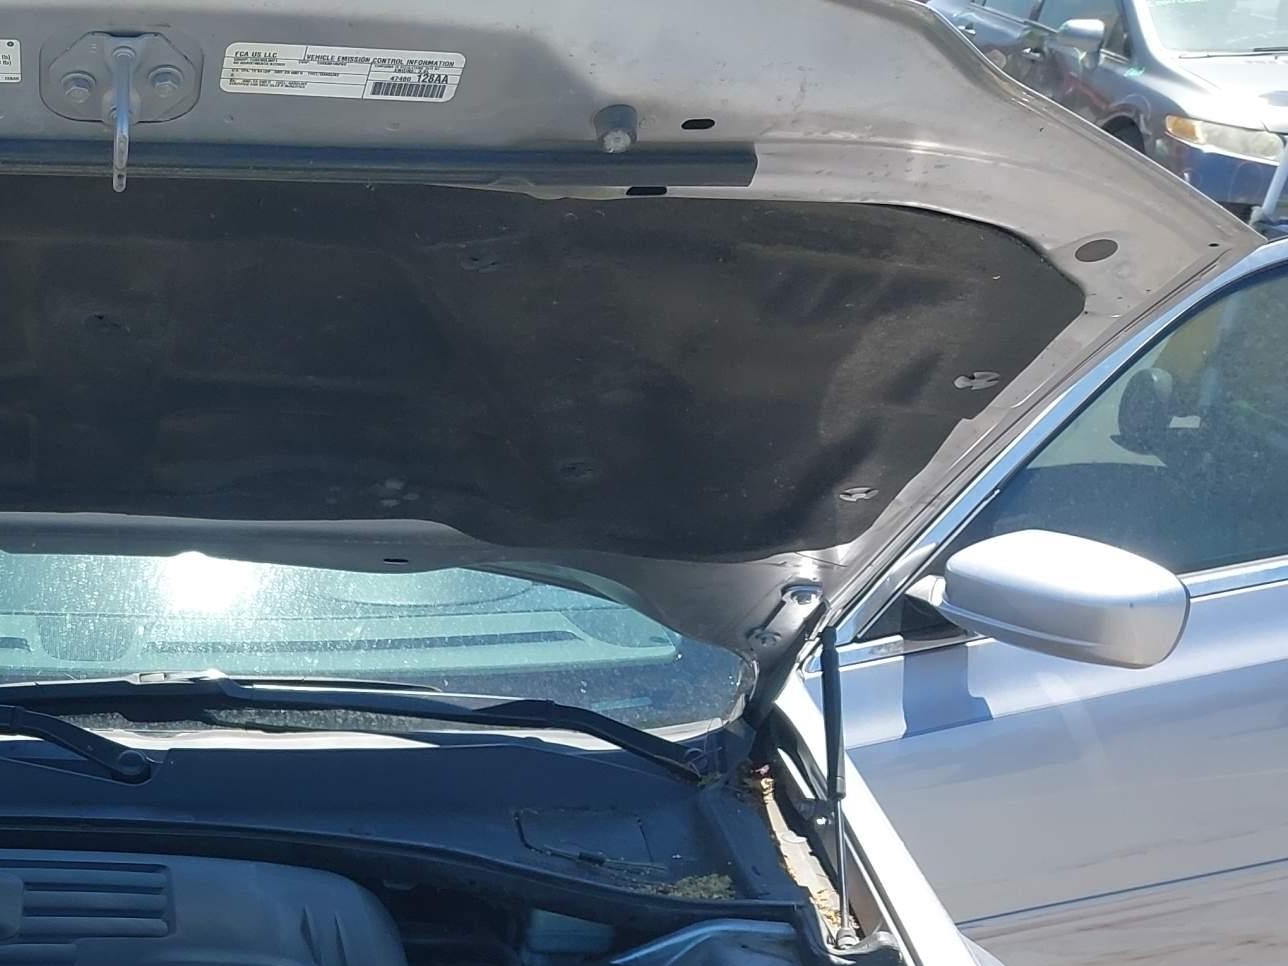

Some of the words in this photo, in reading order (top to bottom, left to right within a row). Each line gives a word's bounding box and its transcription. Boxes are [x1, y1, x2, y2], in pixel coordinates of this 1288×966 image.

[306, 54, 334, 62] VEHICLE
[337, 55, 371, 63] EMISSION
[372, 57, 404, 65] CONTROL
[406, 59, 455, 67] INFORMATION
[416, 74, 449, 84] 128AA
